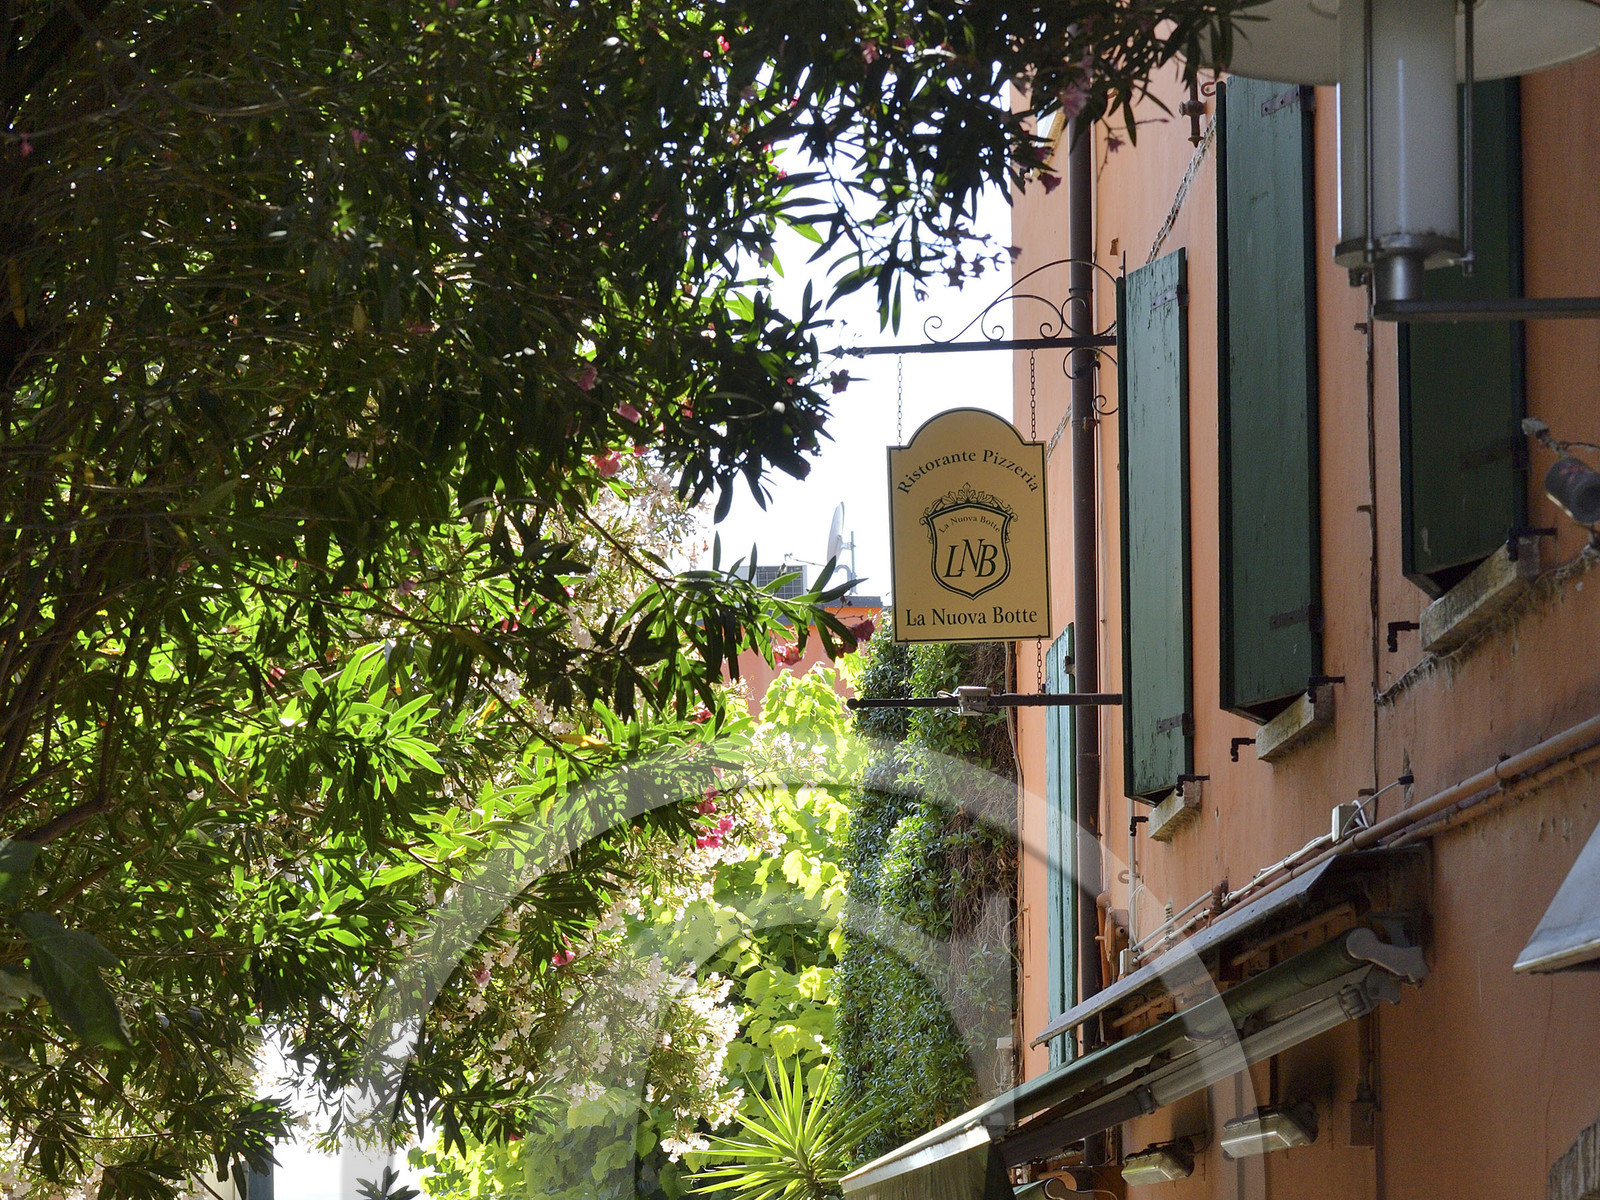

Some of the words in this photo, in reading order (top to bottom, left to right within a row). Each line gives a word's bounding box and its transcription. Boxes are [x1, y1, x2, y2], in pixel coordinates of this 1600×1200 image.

[896, 450, 977, 494] Ristorante
[982, 449, 1039, 492] Pizzeria
[938, 522, 950, 534] La
[950, 516, 978, 526] Nuova
[979, 515, 1001, 533] Botte
[943, 538, 998, 578] LNB
[905, 608, 926, 626] La
[931, 607, 987, 625] Nuova
[992, 606, 1038, 624] Botte
